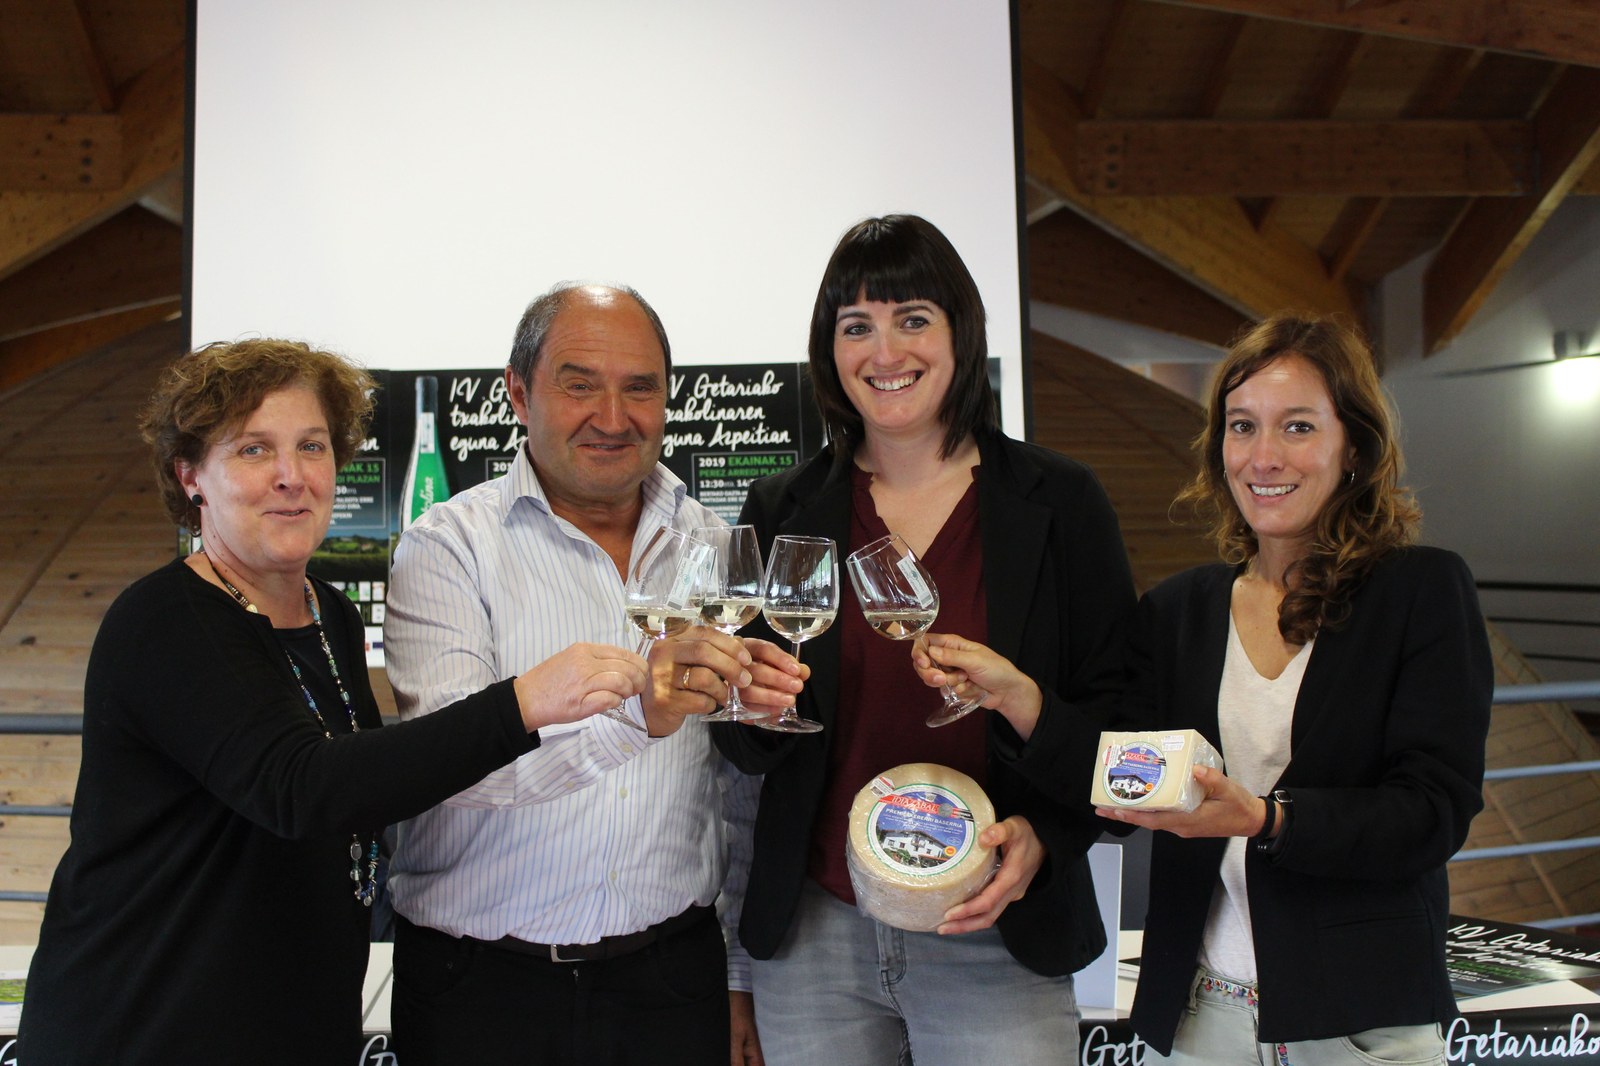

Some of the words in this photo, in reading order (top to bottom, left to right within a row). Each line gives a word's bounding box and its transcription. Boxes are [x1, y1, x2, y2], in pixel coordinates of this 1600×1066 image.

[694, 370, 784, 400] Getariako
[450, 400, 523, 427] txakolin
[664, 396, 766, 424] xakolinaren
[450, 436, 499, 462] eguna
[662, 432, 705, 458] guna
[708, 422, 792, 452] Azpeitian
[367, 463, 380, 473] 15
[699, 457, 726, 467] 2019
[728, 456, 776, 466] EKAINAK
[780, 455, 792, 465] 15
[699, 469, 726, 477] PEREZ
[1446, 1012, 1600, 1063] Getariako
